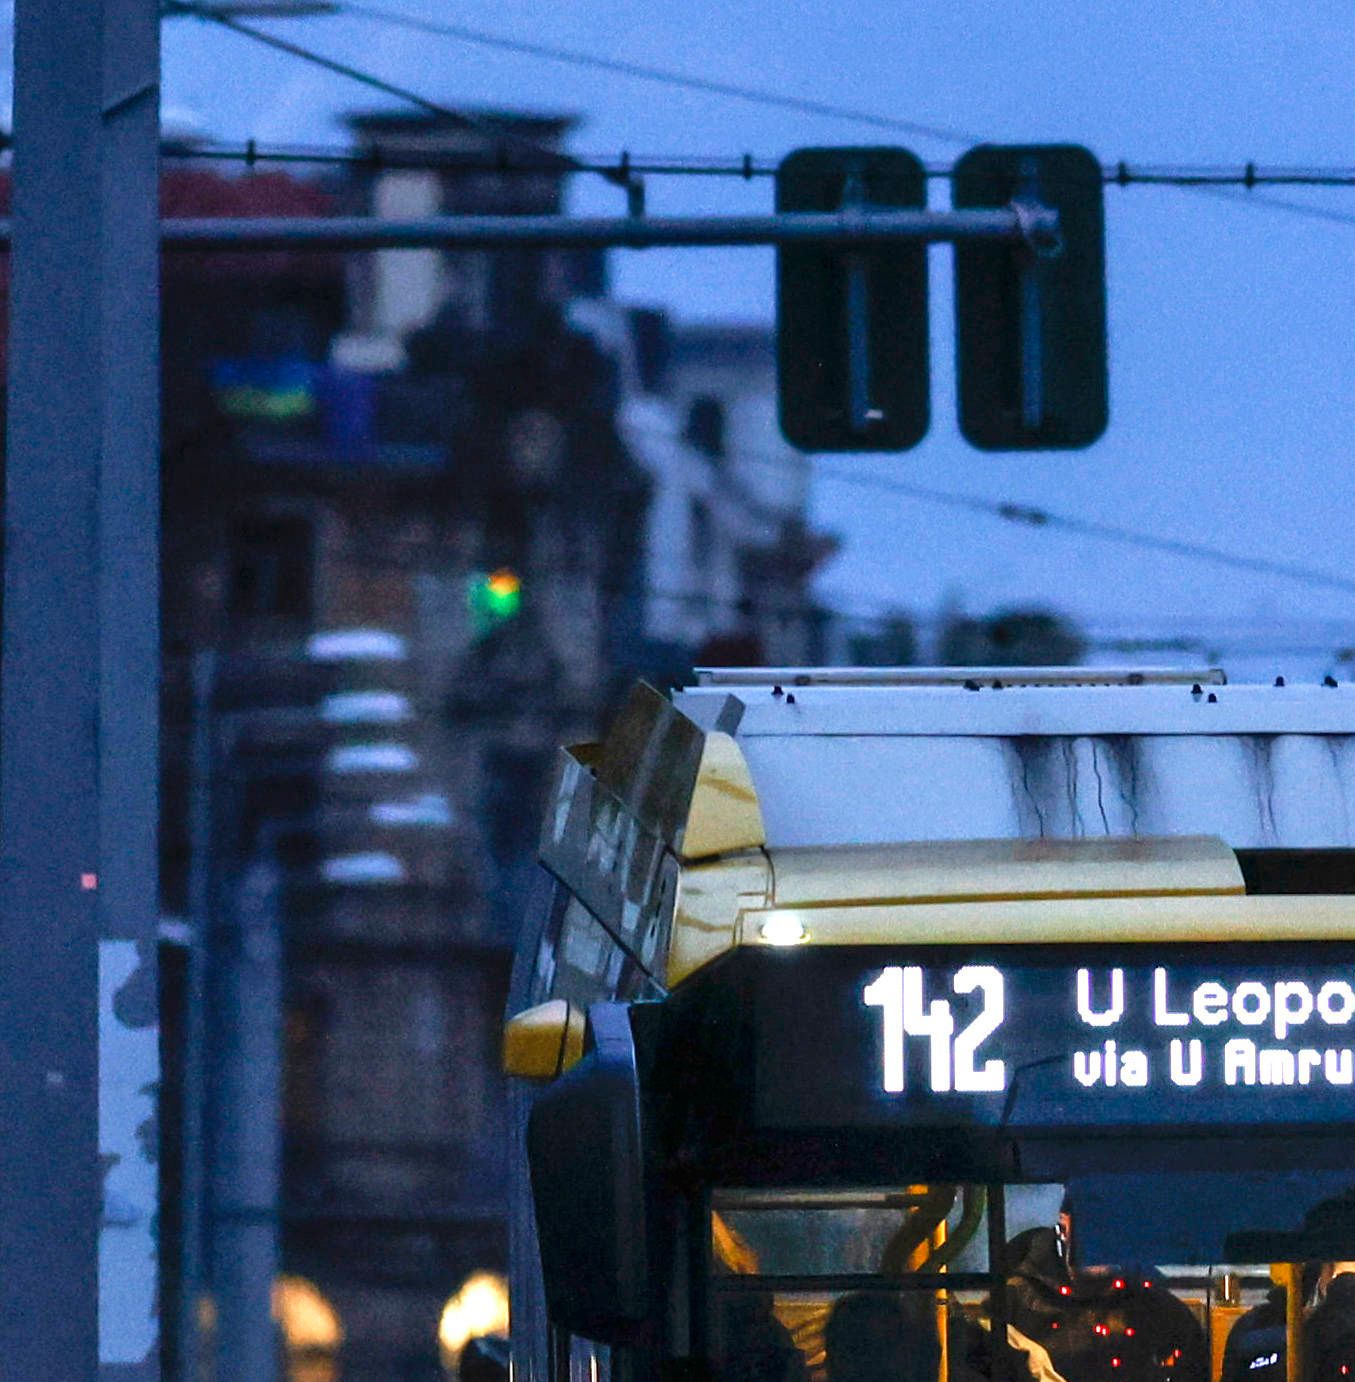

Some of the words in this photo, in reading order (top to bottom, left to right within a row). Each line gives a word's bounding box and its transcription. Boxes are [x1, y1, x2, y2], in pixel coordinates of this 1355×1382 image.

[1076, 967, 1125, 1028] U
[863, 965, 1007, 1094] 142
[1073, 1040, 1149, 1087] via
[1169, 1040, 1204, 1087] U
